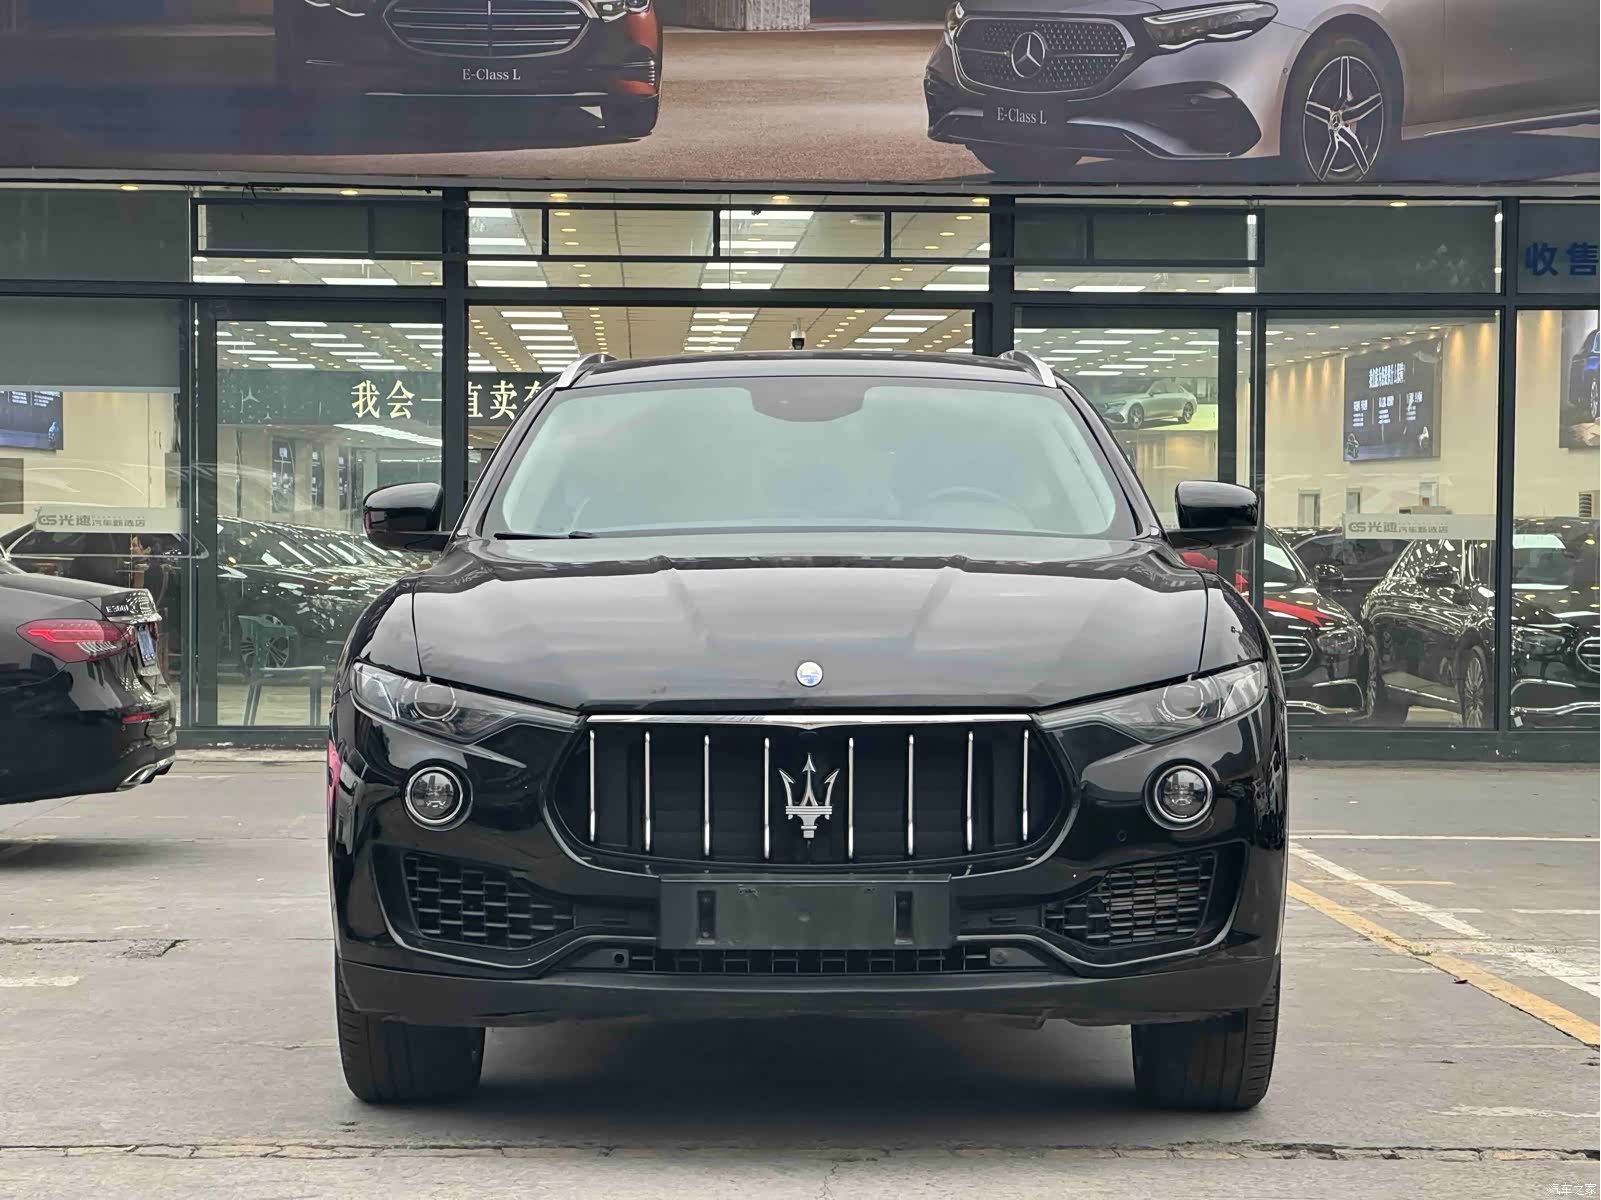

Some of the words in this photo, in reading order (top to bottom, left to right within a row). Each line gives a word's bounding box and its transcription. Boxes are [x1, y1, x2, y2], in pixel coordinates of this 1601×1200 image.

[462, 68, 509, 81] E-Class
[512, 68, 521, 81] L
[997, 106, 1037, 124] E-Class
[1040, 110, 1048, 125] L
[1525, 241, 1599, 276] 收售
[1548, 1182, 1597, 1196] 汽车之家
